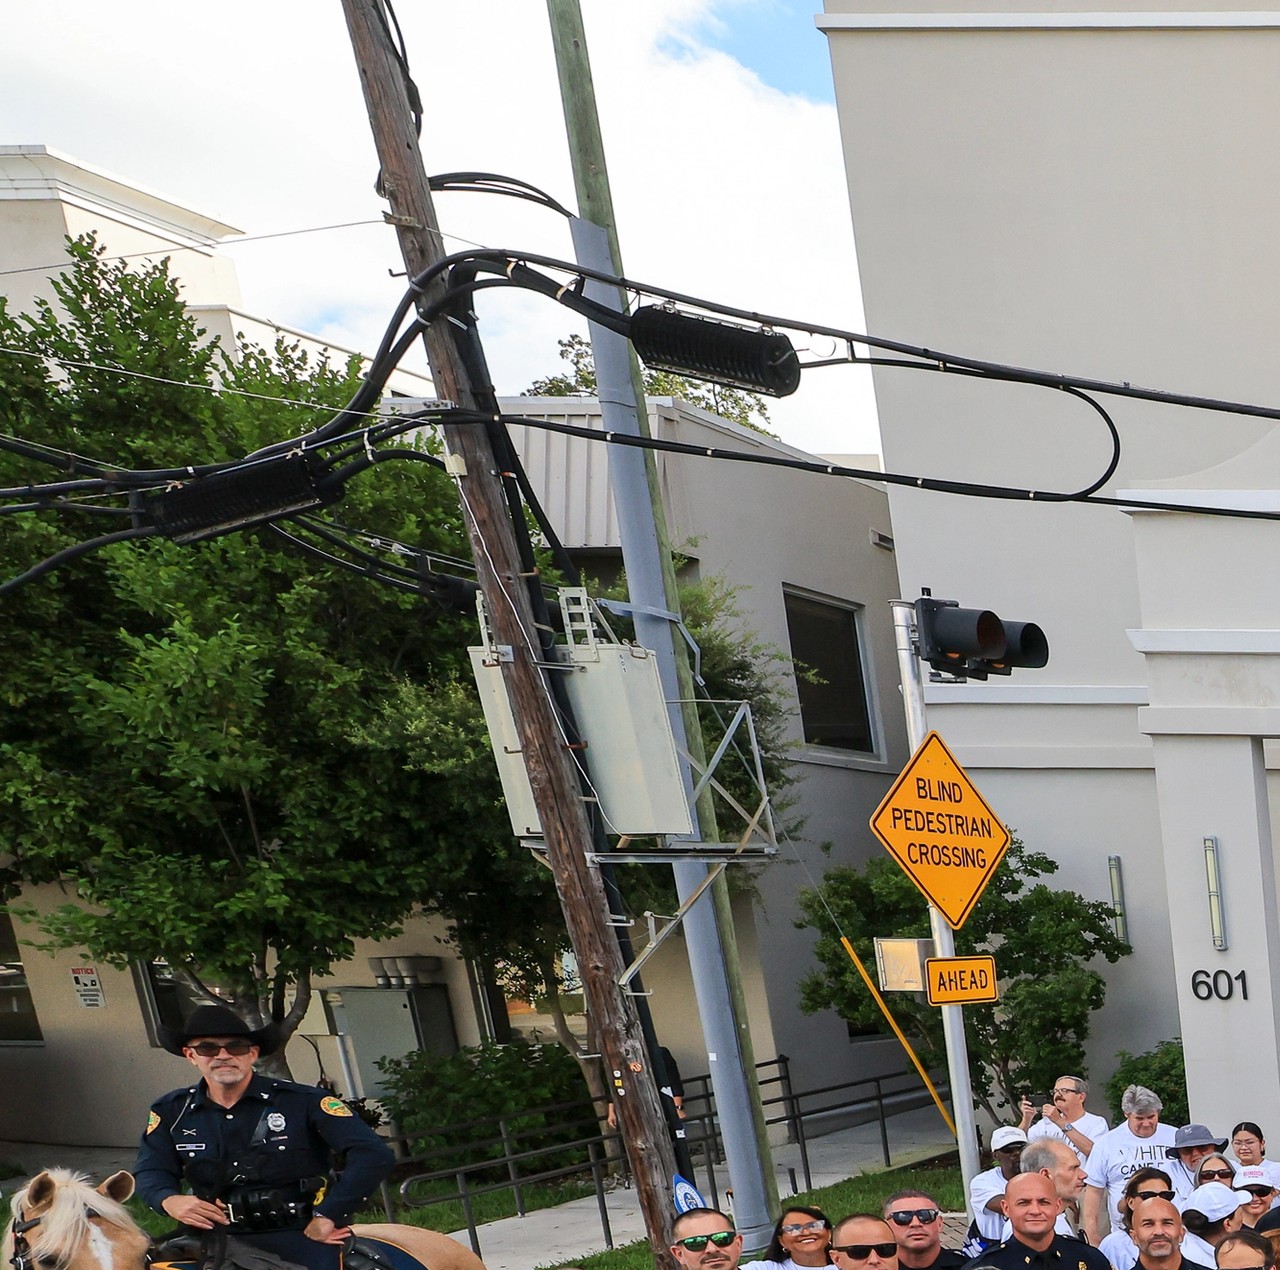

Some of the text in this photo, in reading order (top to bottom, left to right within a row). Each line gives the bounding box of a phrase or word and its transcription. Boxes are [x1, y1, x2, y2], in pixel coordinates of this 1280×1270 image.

[916, 777, 963, 803] BLIND
[891, 807, 992, 838] PEDESTRIAN
[907, 842, 987, 869] CROSSING
[937, 969, 988, 992] AHEAD
[1191, 969, 1248, 1001] 601
